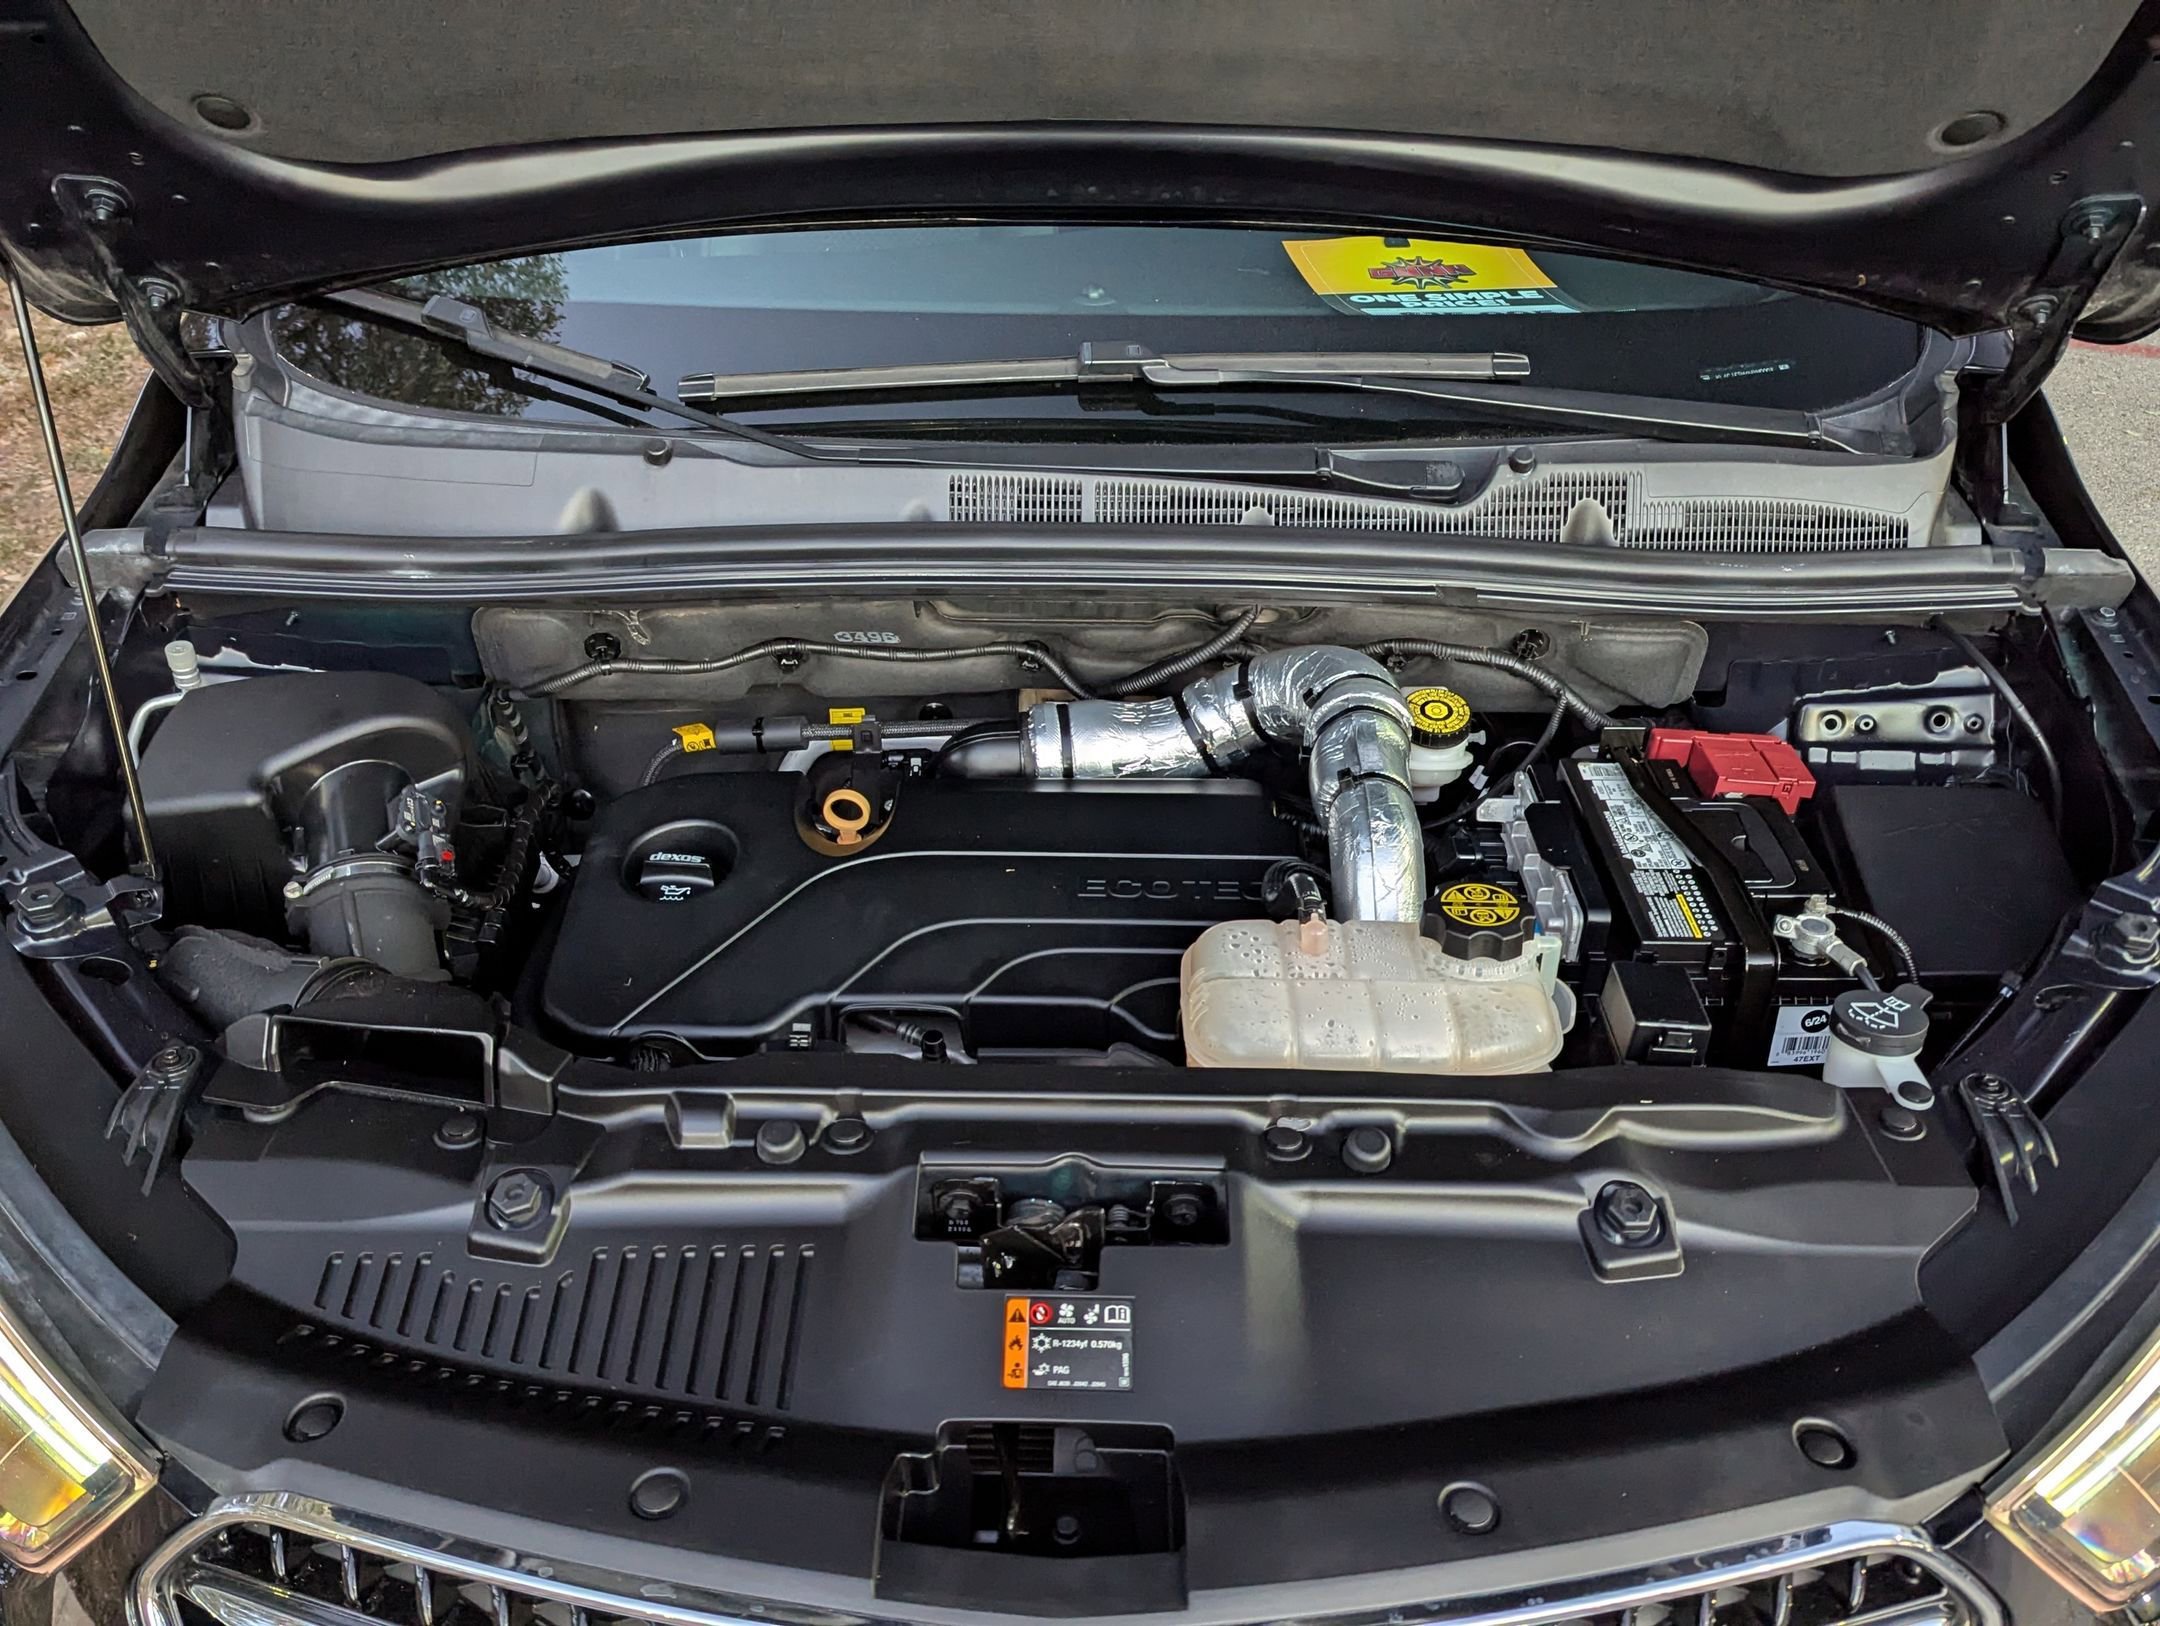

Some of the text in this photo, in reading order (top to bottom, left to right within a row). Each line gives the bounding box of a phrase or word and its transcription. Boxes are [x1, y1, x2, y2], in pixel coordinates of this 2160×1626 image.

[1349, 290, 1544, 303] ONE SIMPLE
[1400, 299, 1510, 308] PRICE!
[649, 852, 705, 863] dexos
[1804, 1015, 1827, 1027] 6/24
[1057, 1317, 1076, 1325] AUTO
[1052, 1365, 1070, 1375] PAG
